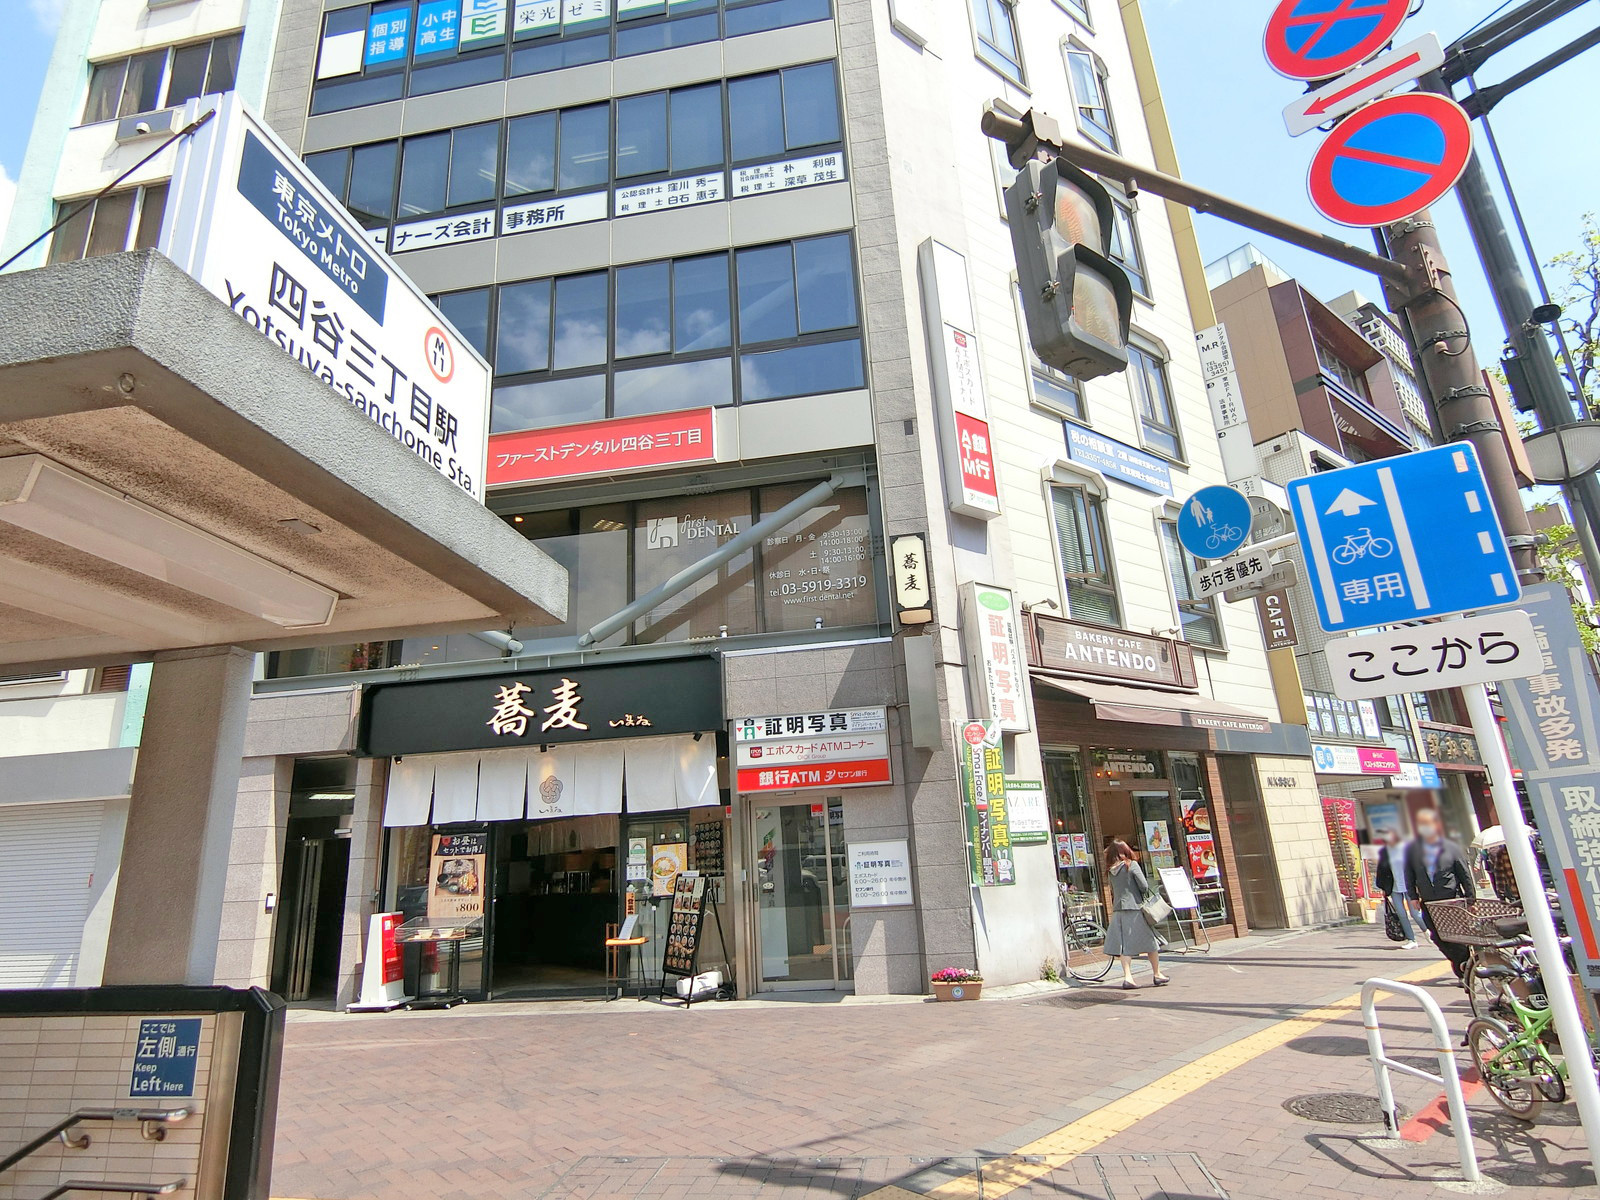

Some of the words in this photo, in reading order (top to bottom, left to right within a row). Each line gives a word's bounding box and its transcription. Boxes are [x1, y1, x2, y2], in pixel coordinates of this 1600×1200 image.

[372, 20, 407, 37] 個別
[421, 10, 457, 26] 小中
[370, 36, 405, 56] 指導
[420, 27, 456, 45] 高生
[621, 186, 663, 199] 公認会計士
[667, 194, 690, 206] 白石
[273, 169, 366, 281] 東京メトロ
[506, 204, 565, 229] 事務所
[277, 206, 318, 257] Tokyo
[320, 247, 359, 295] Metro
[434, 336, 445, 356] M
[1201, 341, 1219, 352] M.R
[268, 261, 458, 454] 四谷三丁目駅
[432, 350, 445, 373] 11
[496, 428, 702, 468] ファーストデンタル四谷三丁目
[961, 429, 976, 476] ATM
[971, 433, 990, 480] 銀行
[448, 457, 476, 496] Sta.
[681, 514, 706, 534] first
[687, 523, 740, 539] DENTAL
[809, 550, 818, 559] 土
[902, 552, 921, 592] 蕎麦
[1199, 556, 1264, 592] 歩行者優先
[1340, 572, 1406, 605] 専用
[1266, 595, 1288, 639] CAFE
[1074, 630, 1114, 645] BAKERY
[1117, 638, 1143, 650] CAFE
[1064, 642, 1156, 672] ANTENDO
[1347, 631, 1520, 683] ここから
[485, 678, 588, 737] 蕎麦
[764, 712, 848, 736] 証明写真
[1197, 718, 1221, 727] BAKERY
[1222, 720, 1238, 728] CAFE
[1238, 722, 1264, 731] ANTENDO
[758, 768, 821, 787] 銀行ATM
[837, 769, 869, 779] セブン銀行
[1103, 761, 1155, 773] ANTENDO
[984, 747, 1009, 848] 証明写真
[141, 1022, 176, 1034] ここでは
[137, 1036, 176, 1059] 左側
[177, 1045, 196, 1058] 通行
[135, 1062, 157, 1074] Keep
[133, 1076, 162, 1092] Left
[163, 1081, 184, 1092] Here
